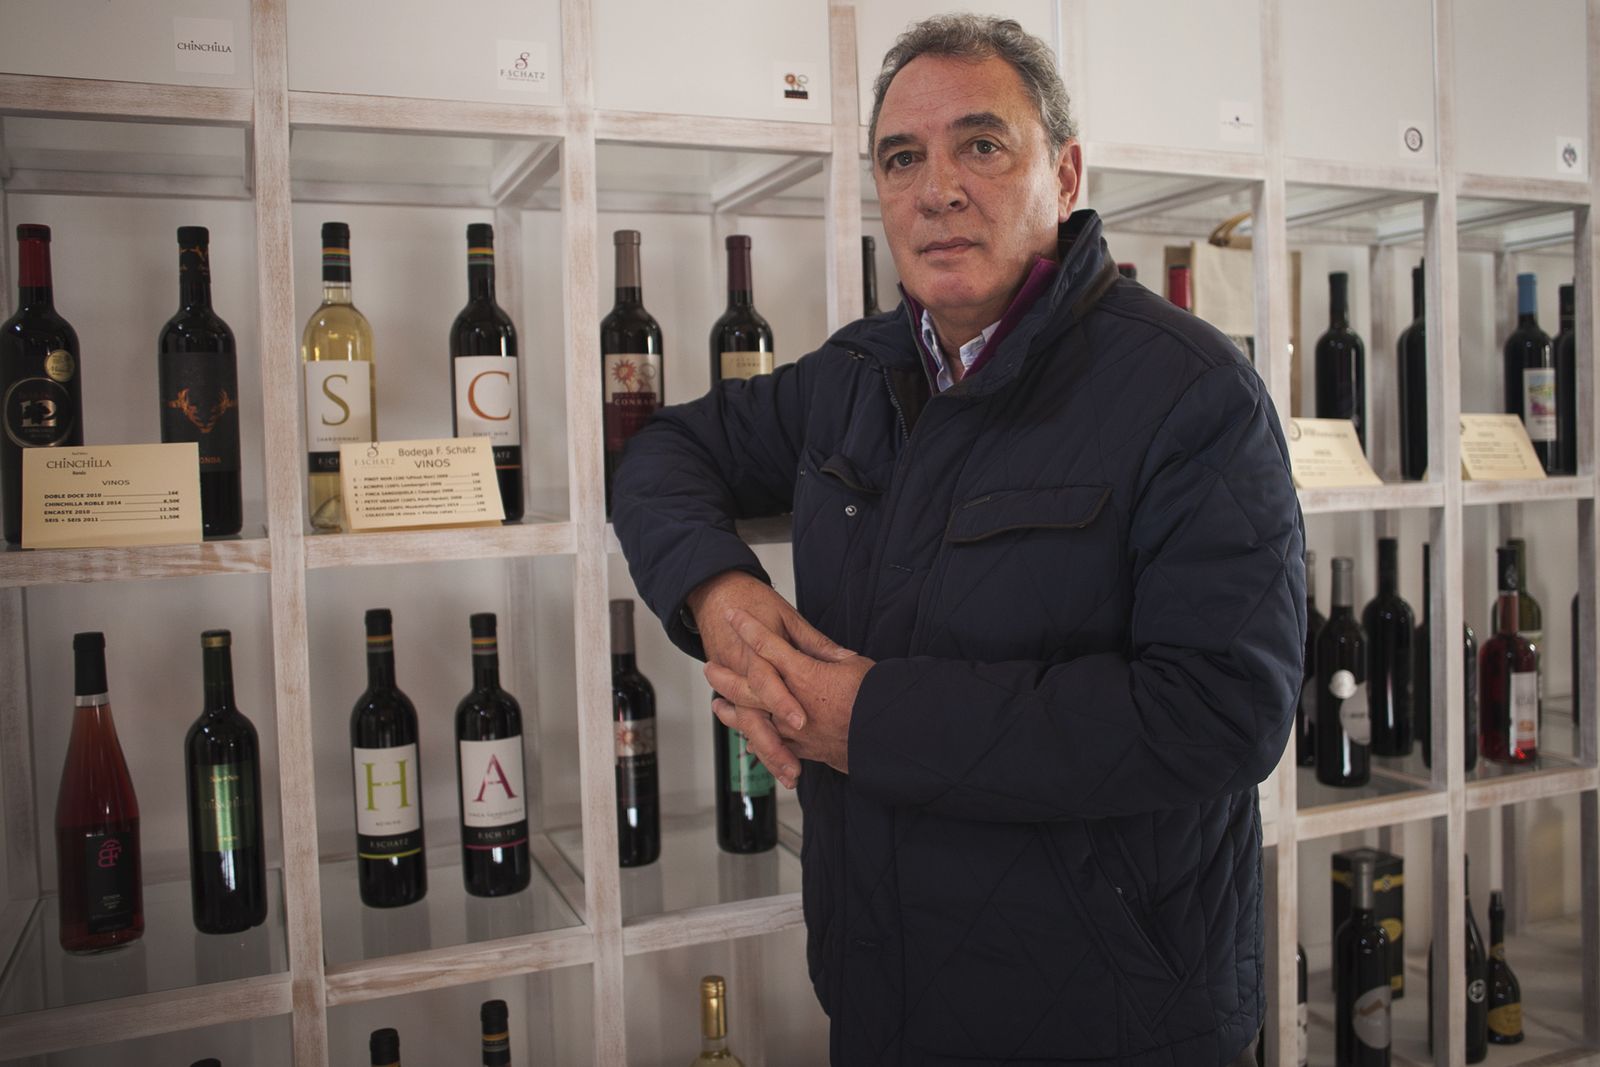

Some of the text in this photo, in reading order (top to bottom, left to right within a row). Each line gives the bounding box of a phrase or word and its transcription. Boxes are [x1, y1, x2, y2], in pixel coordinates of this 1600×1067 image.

[177, 40, 232, 53] CHINCHILLA
[321, 374, 350, 426] S
[467, 371, 511, 421] C
[46, 456, 112, 469] CHINCHILLA
[398, 447, 433, 457] Bodega
[445, 445, 477, 455] Schatz
[414, 458, 451, 468] VINOS
[362, 759, 412, 812] H
[473, 754, 518, 803] A
